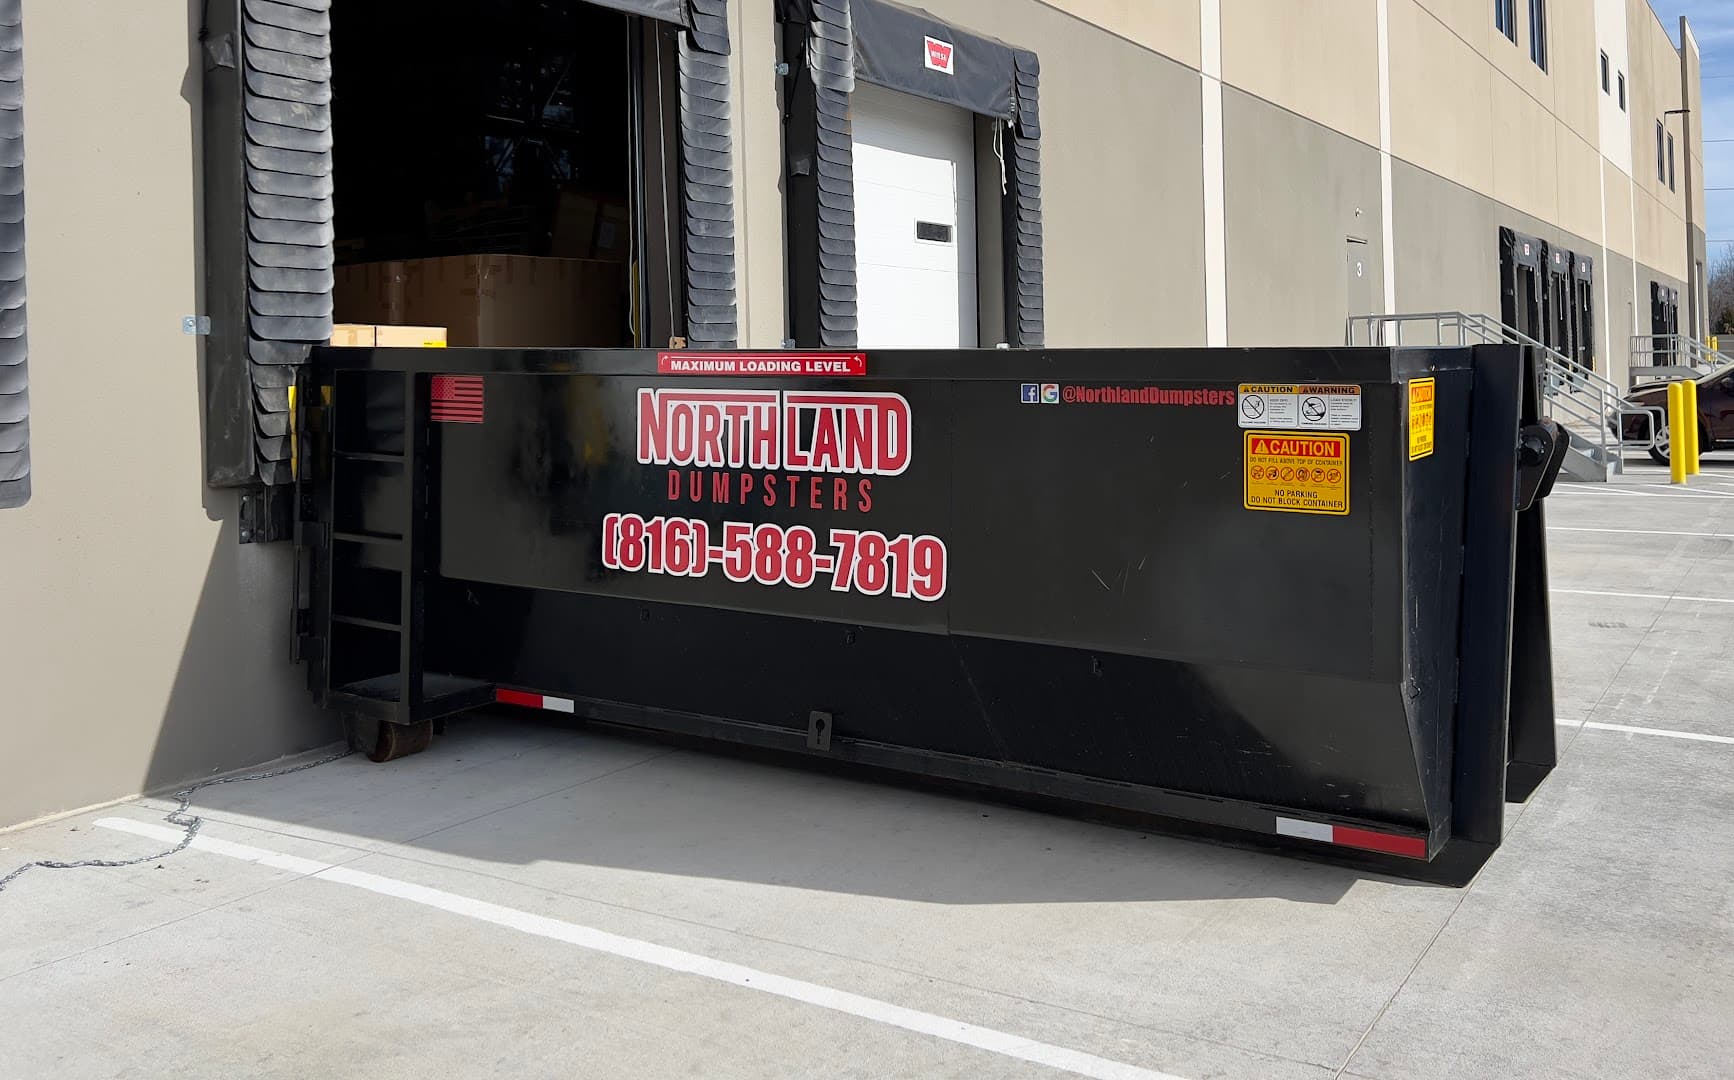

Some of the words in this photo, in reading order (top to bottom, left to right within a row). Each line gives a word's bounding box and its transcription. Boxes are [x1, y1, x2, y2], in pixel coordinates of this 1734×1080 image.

[1356, 261, 1362, 278] 3
[670, 360, 736, 372] MAXIMUM
[739, 361, 801, 372] LOADING
[805, 361, 851, 373] LEVEL
[1062, 386, 1235, 406] @NorthlandDumpsters
[638, 389, 912, 475] NORTHLAND
[1270, 440, 1335, 456] CAUTION
[668, 470, 872, 512] DUMPSTERS
[1287, 490, 1318, 499] PARKING
[1279, 498, 1301, 506] BLOCK
[1304, 500, 1343, 508] CONTAINER
[602, 513, 947, 602] (816)-588-7819
